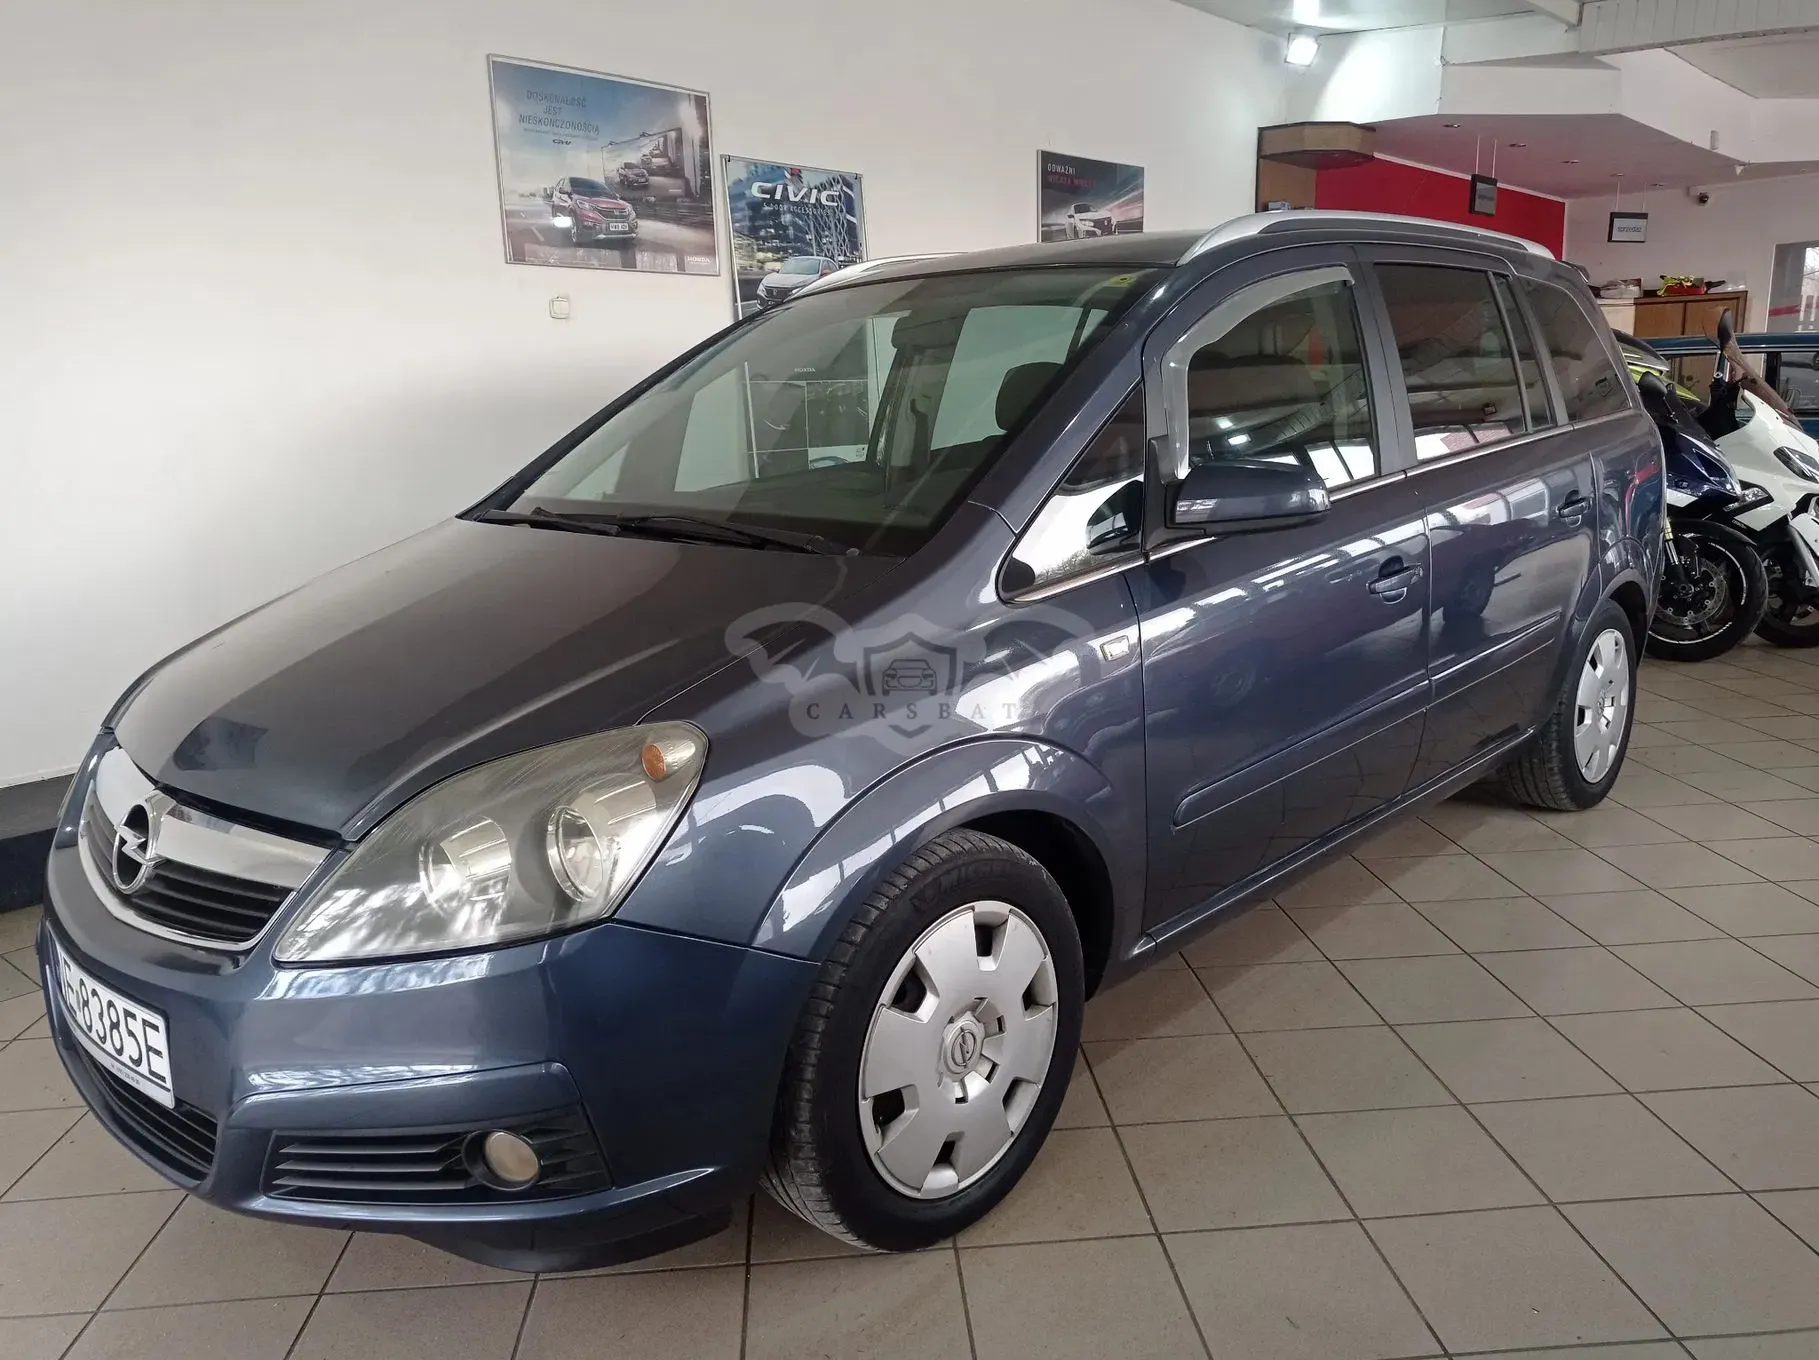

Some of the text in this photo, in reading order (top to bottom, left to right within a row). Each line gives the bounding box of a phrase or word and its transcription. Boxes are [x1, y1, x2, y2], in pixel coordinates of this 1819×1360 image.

[543, 105, 562, 116] JEST
[751, 181, 840, 206] CIVIC
[79, 977, 167, 1085] 8385E
